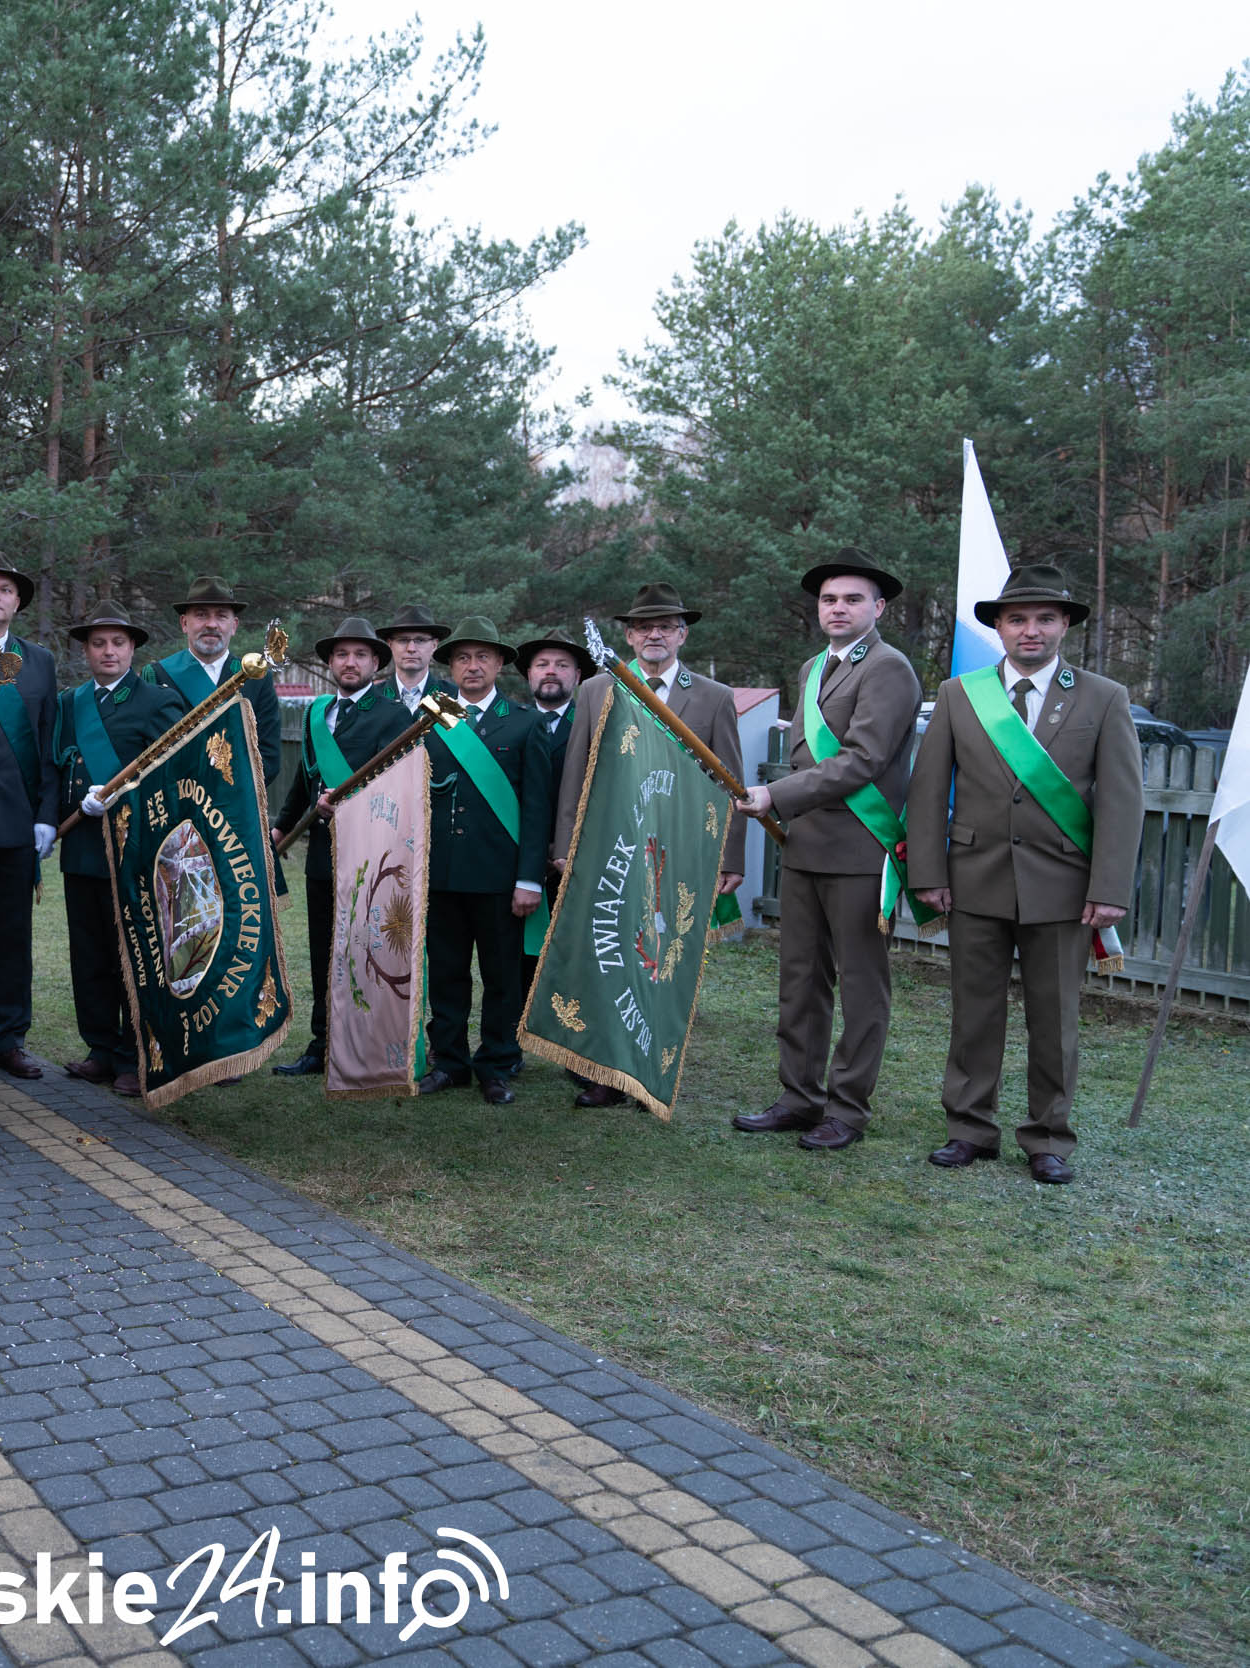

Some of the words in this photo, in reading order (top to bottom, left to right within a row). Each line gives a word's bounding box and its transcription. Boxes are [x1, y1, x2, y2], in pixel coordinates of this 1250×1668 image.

[592, 834, 637, 974] ZWIĄZEK
[216, 955, 253, 999] NR
[192, 996, 221, 1033] 102
